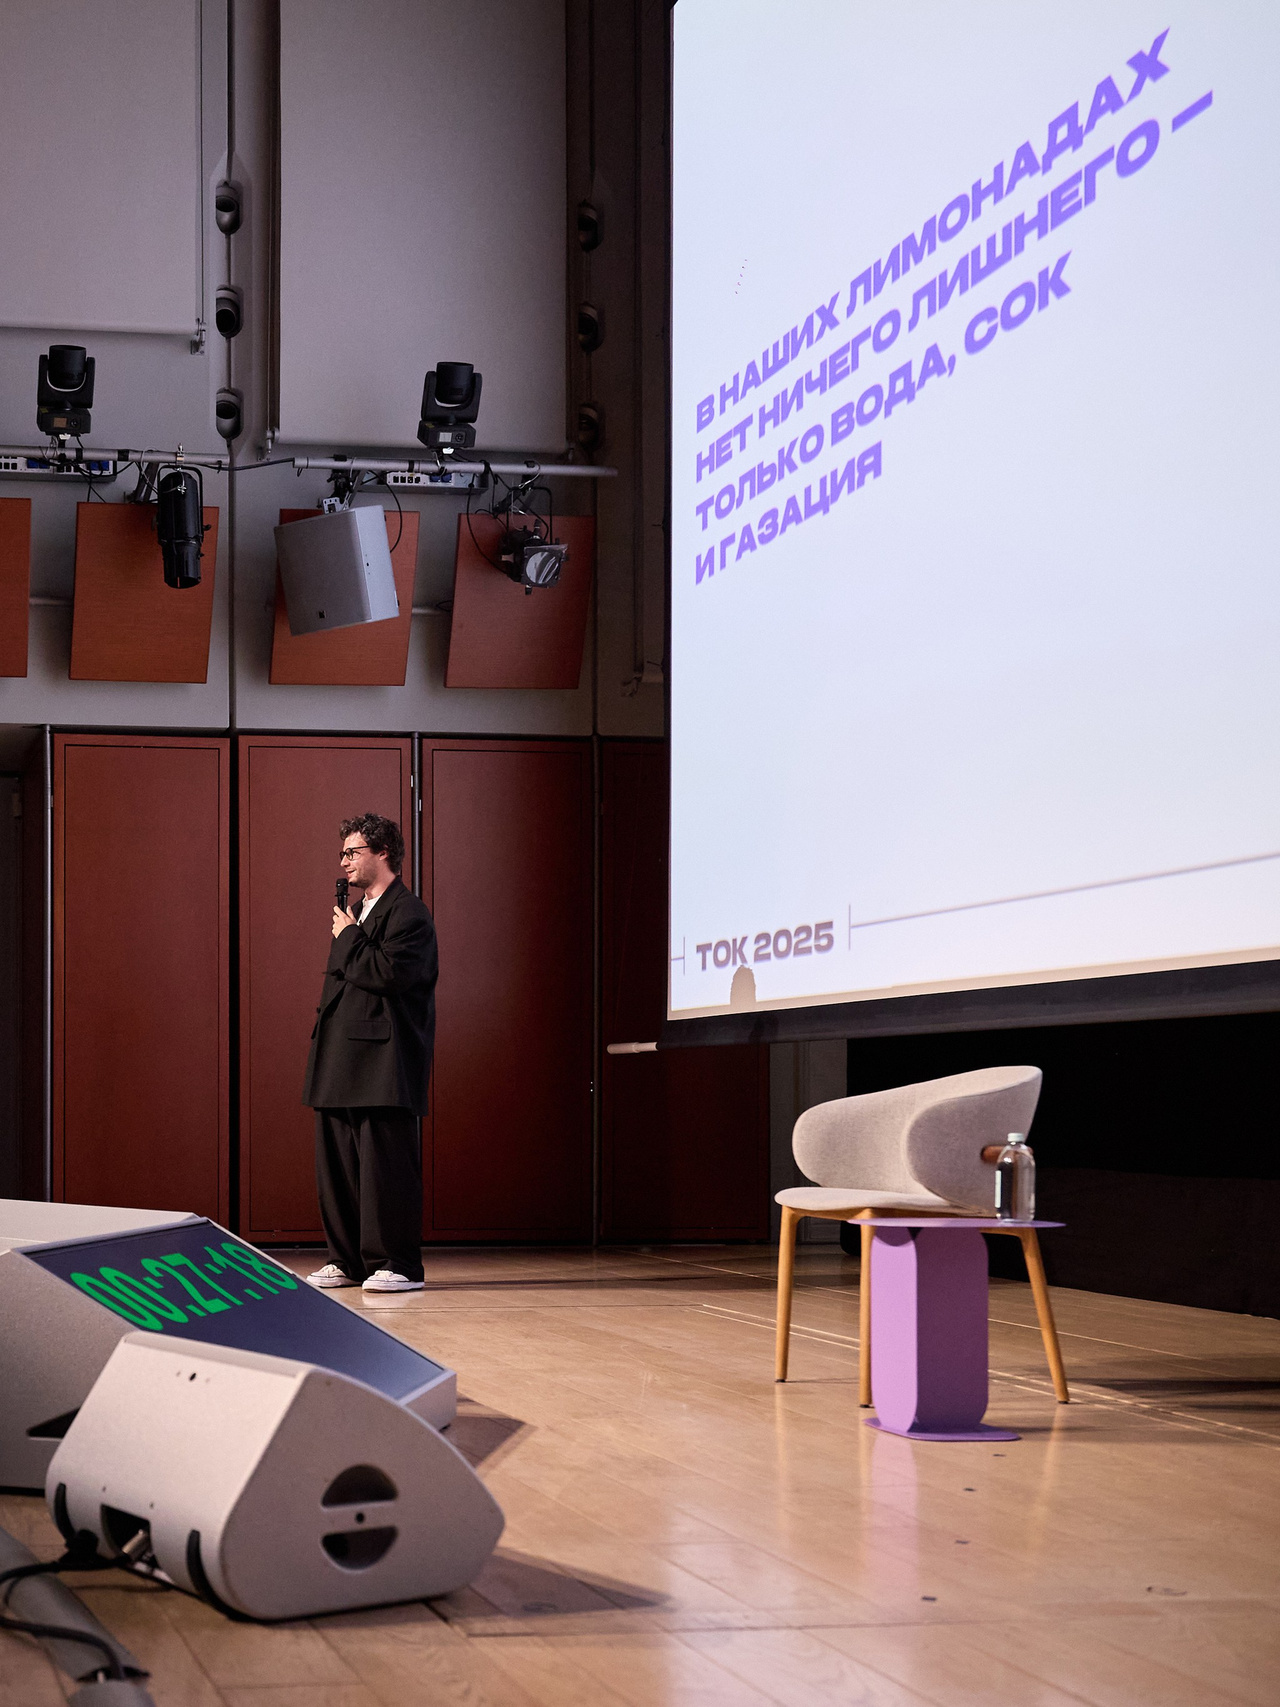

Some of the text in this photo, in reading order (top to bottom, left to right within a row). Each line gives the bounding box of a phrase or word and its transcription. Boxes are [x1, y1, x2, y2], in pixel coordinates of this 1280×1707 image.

[695, 27, 1171, 434] В НАШИХ ЛИМОНАДАХ
[695, 413, 754, 484] НЕТ
[758, 307, 902, 440] НИЧЕГО
[907, 117, 1161, 333] ЛИШНЕГО
[695, 250, 1072, 532] ТОЛЬКО ВОДА, СОК
[695, 439, 883, 586] И ГАЗАЦИЯ
[696, 920, 835, 972] ТОК 2025
[69, 1242, 299, 1331] 00:27:18
